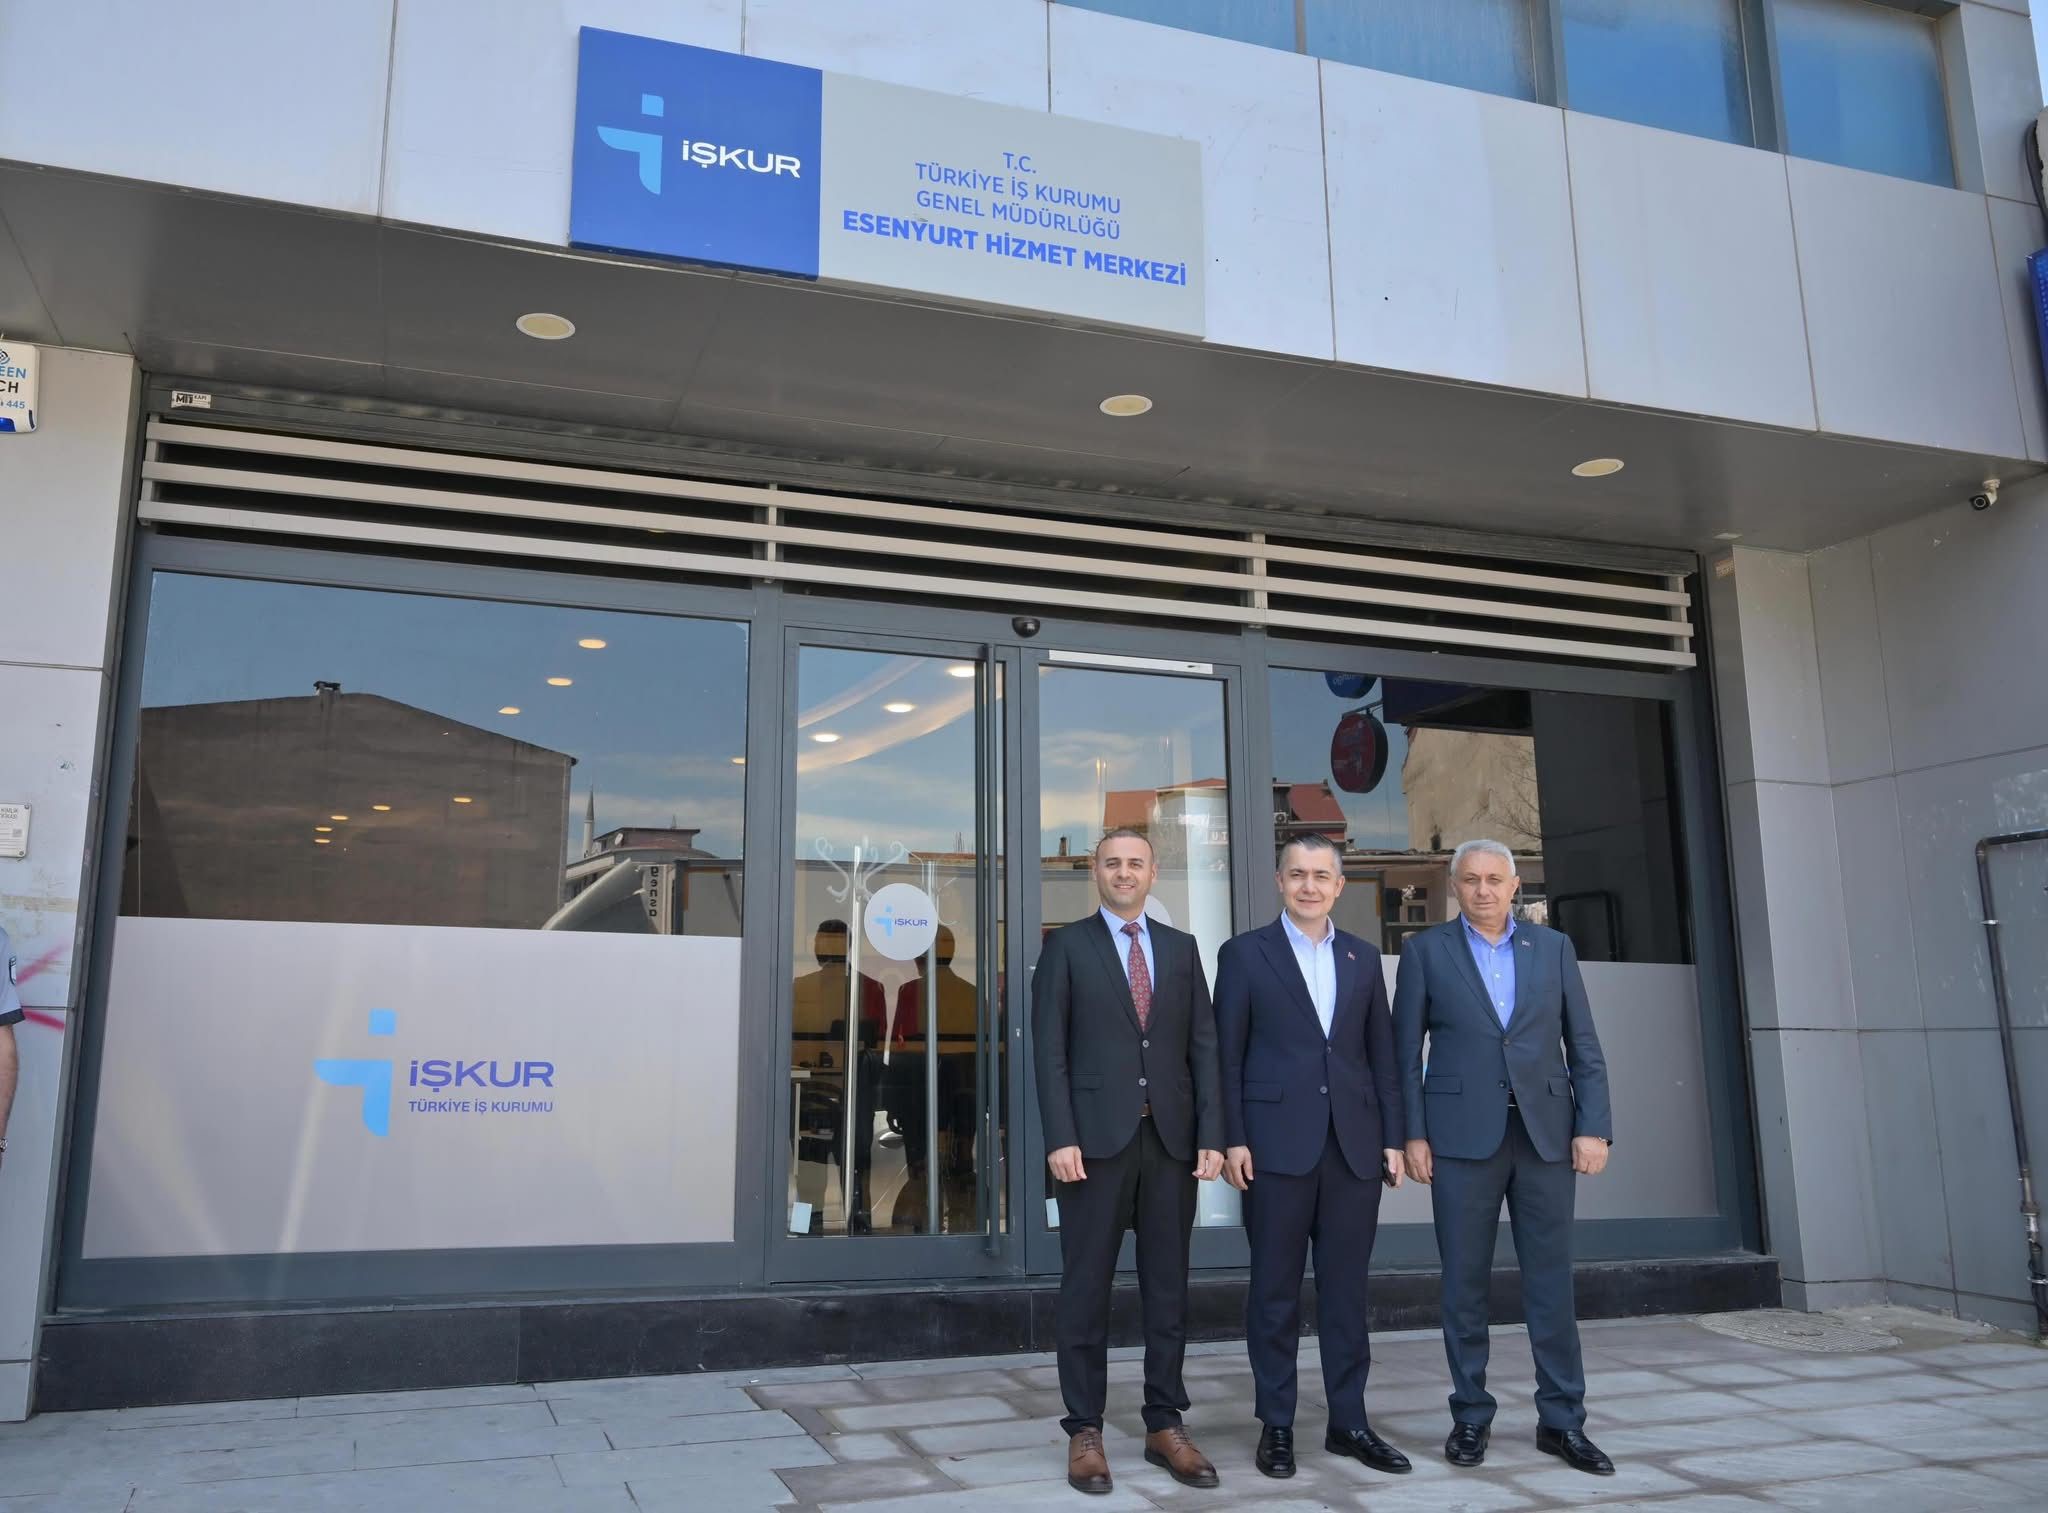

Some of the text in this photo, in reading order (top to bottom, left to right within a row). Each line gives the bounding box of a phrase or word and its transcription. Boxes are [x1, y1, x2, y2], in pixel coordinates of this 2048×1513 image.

[915, 162, 1121, 214] TÜRKİYE İŞ KURUMU
[1003, 152, 1036, 174] T.C.
[916, 190, 1120, 240] GENEL MÜDÜRLÜĞÜ
[842, 209, 1187, 287] ESENYURT HİZMET MERKEZİ
[408, 1099, 553, 1114] TÜRKİYE İŞ KURUMU
